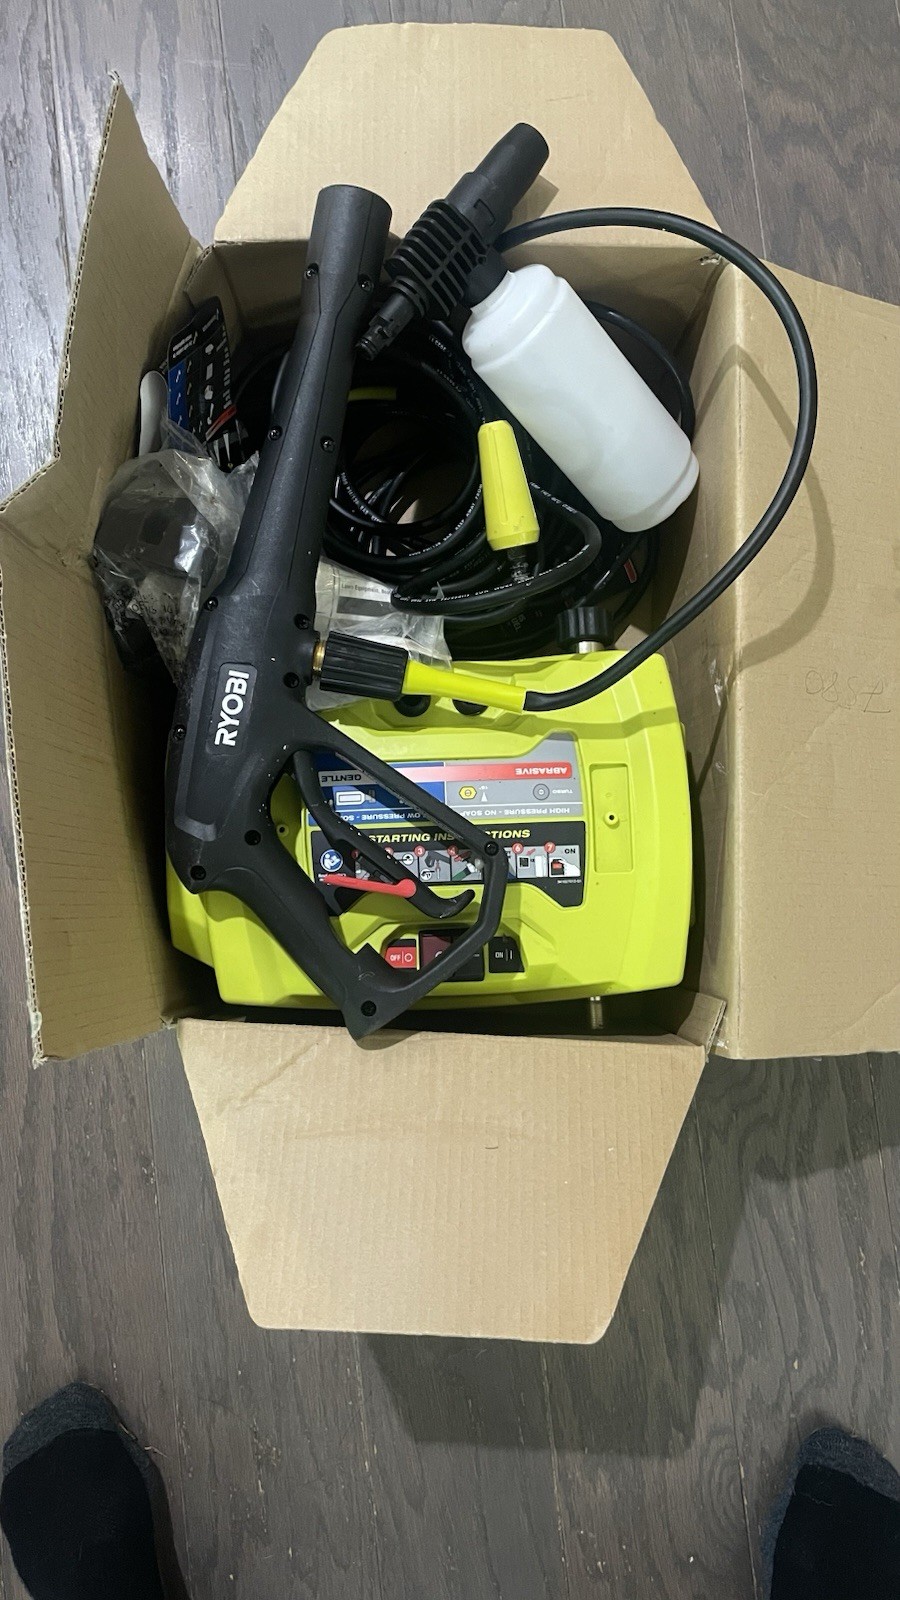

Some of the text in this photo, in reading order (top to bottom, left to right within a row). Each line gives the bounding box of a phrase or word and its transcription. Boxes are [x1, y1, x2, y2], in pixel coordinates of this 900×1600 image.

[214, 670, 250, 746] RYOBI
[515, 767, 567, 775] ABRASIVE
[321, 774, 362, 783] GENTLE
[361, 813, 404, 821] PRESSURE
[368, 833, 431, 844] STARTING
[389, 954, 401, 962] OFF
[495, 951, 503, 959] ON
